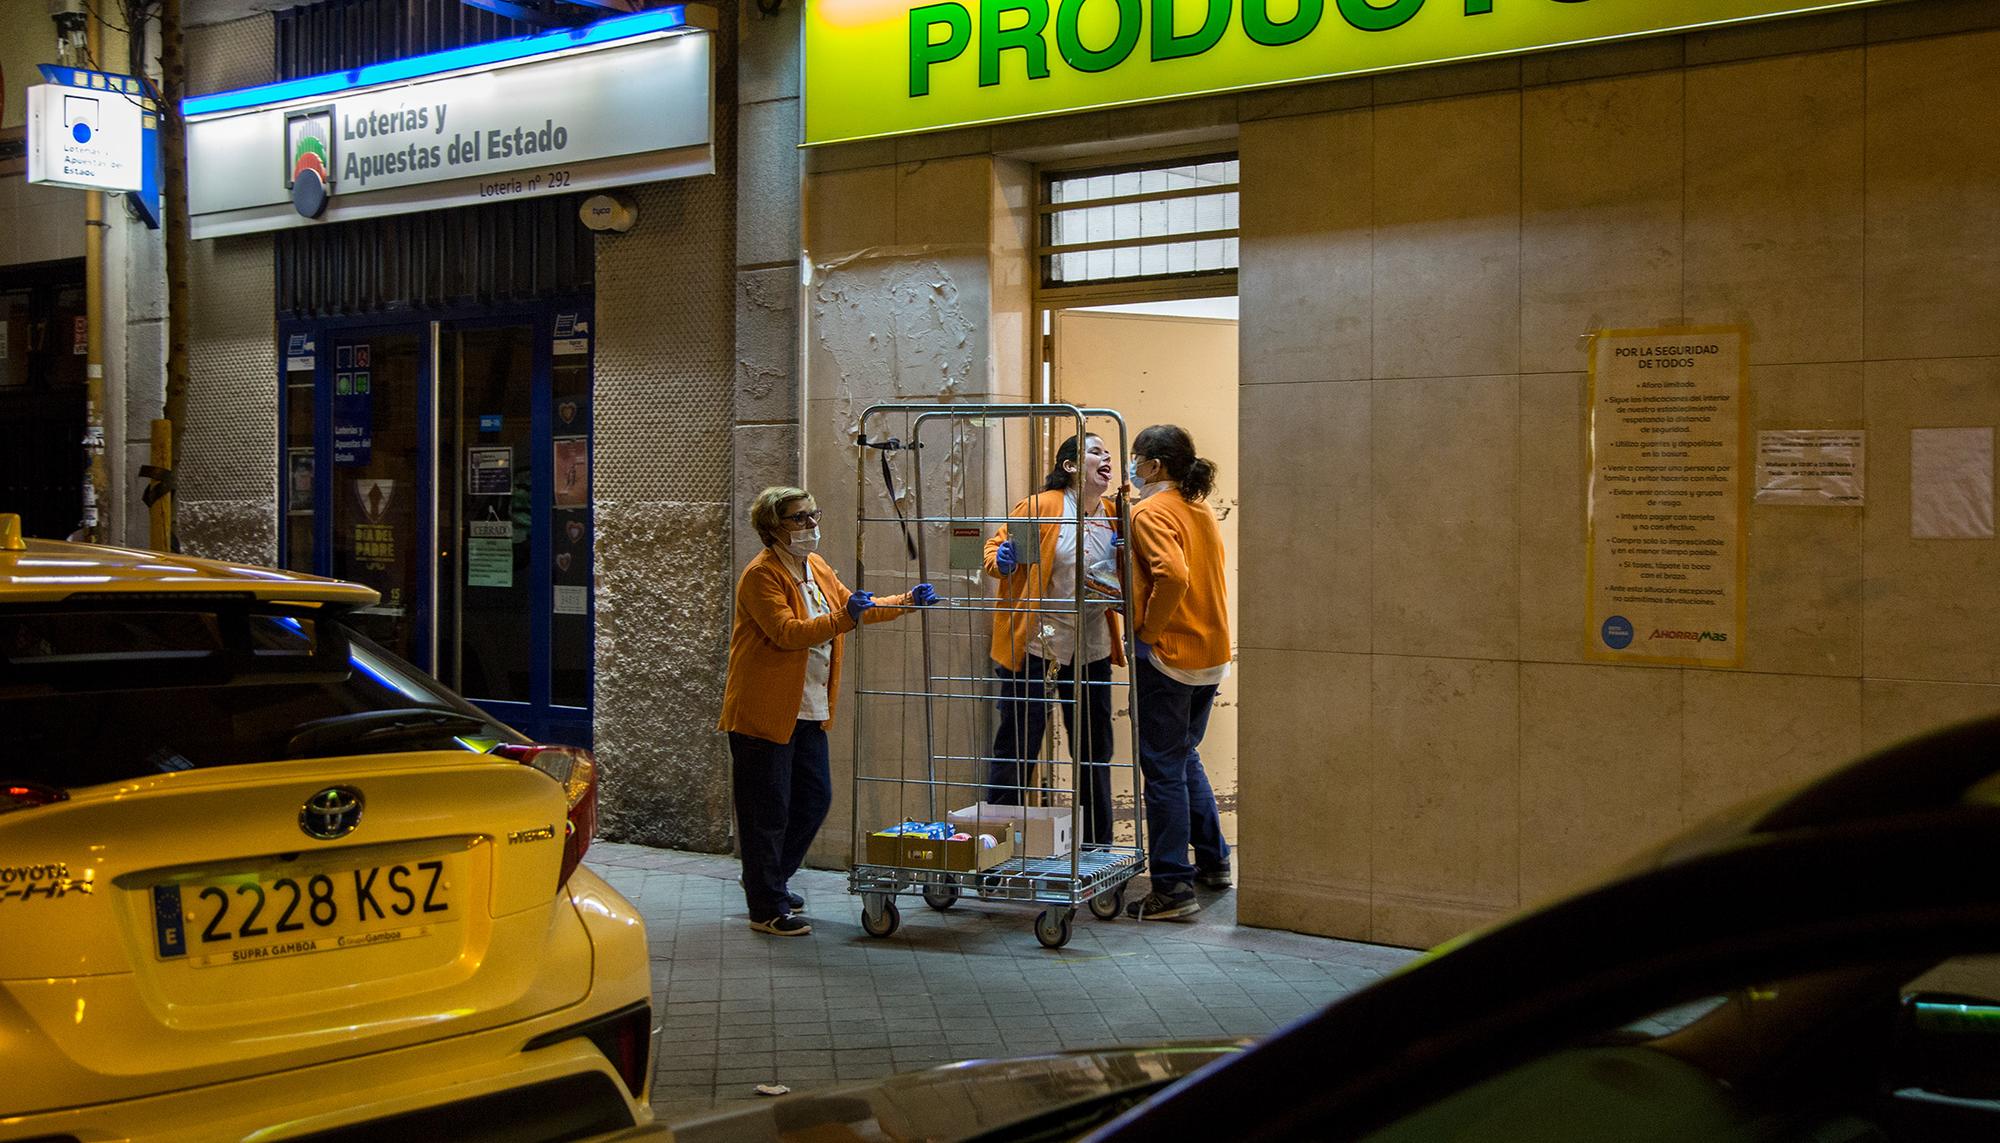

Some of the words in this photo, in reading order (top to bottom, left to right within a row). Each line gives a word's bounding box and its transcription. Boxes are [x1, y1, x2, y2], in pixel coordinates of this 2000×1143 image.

[909, 0, 1593, 98] PRODU
[344, 102, 428, 141] Loterías
[435, 103, 448, 134] y
[343, 142, 441, 186] Apuestas
[447, 130, 480, 166] del
[487, 119, 568, 160] Estado
[548, 171, 570, 188] 292
[1616, 348, 1638, 357] POR
[1640, 347, 1652, 356] LA
[1655, 345, 1719, 356] SEGURIDAD
[1638, 360, 1652, 369] DE
[1656, 358, 1694, 368] TODOS
[355, 542, 395, 557] PADRE
[199, 873, 338, 943] 2228
[353, 860, 449, 922] KSZ
[165, 927, 177, 945] E
[232, 945, 269, 961] SUPRA
[271, 940, 317, 955] GAMBOA
